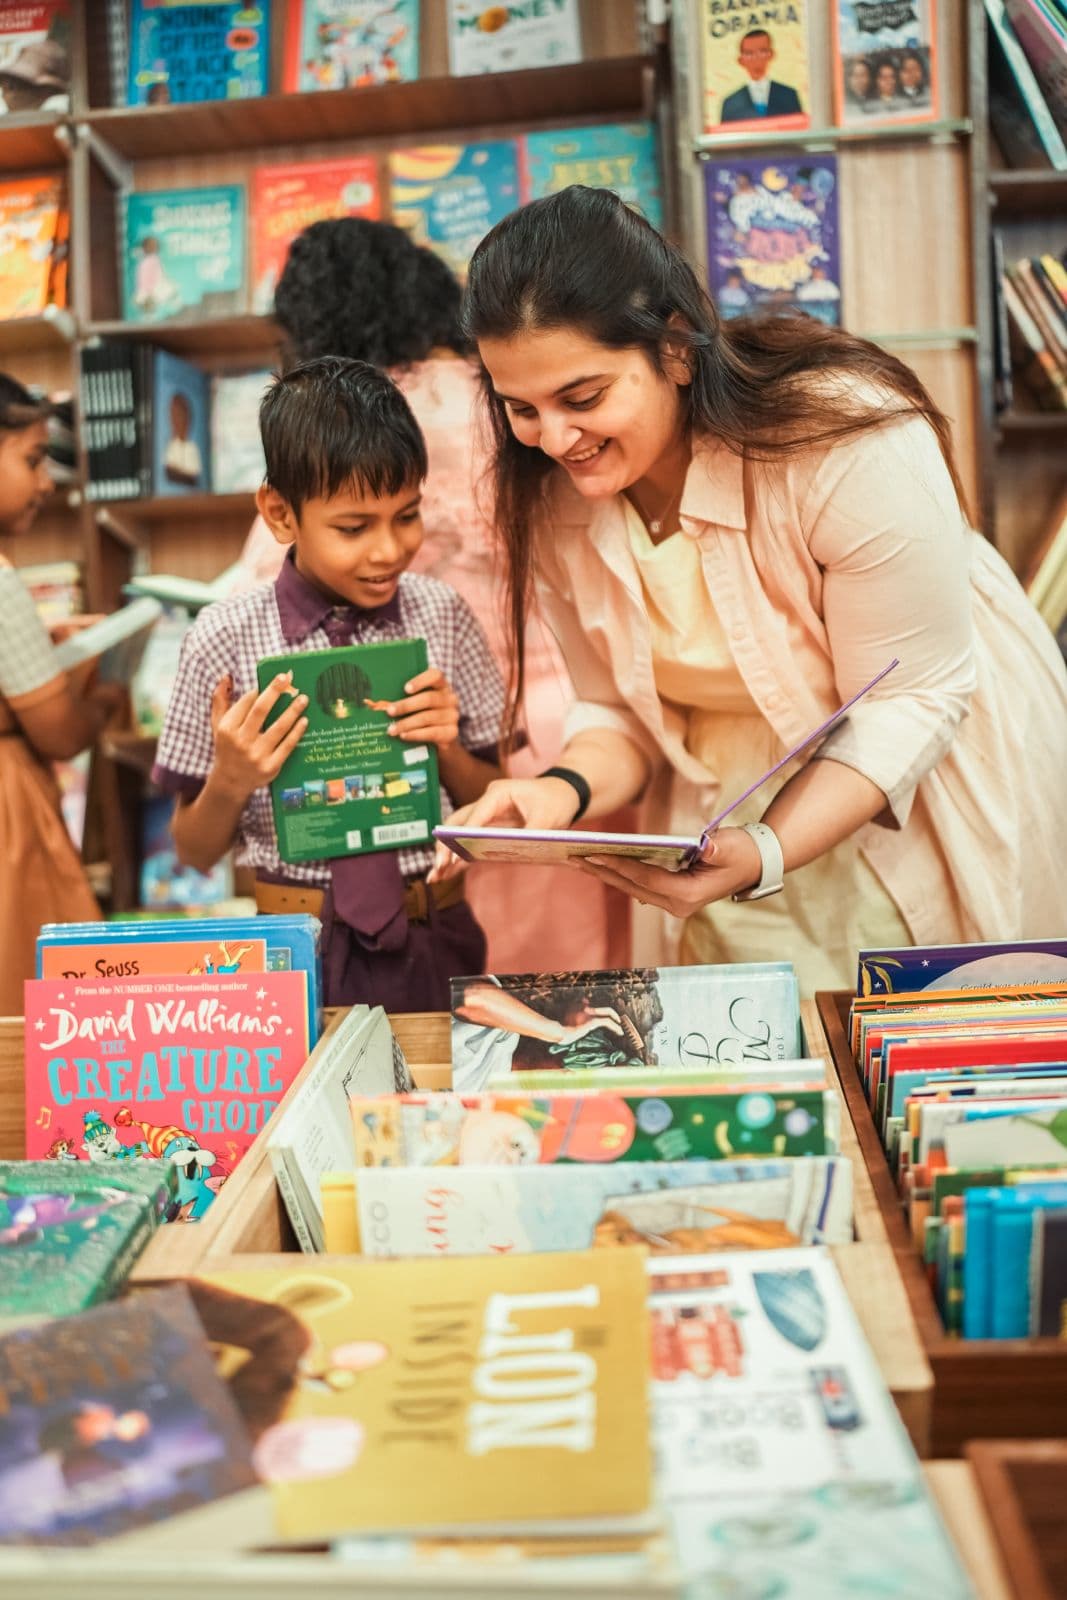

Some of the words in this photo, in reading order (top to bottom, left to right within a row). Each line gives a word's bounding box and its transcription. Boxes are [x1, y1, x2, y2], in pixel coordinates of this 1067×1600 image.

[710, 4, 799, 38] OBAMA
[94, 958, 140, 978] Seuss
[75, 985, 98, 996] From
[98, 985, 112, 995] the
[113, 984, 153, 995] NUMBER
[154, 983, 175, 993] ONE
[175, 982, 220, 993] bestselling
[220, 981, 249, 992] author
[40, 999, 137, 1051] David
[144, 998, 284, 1036] Walliams
[100, 1039, 127, 1055] THE
[47, 1045, 283, 1106] CREATURE
[465, 1283, 600, 1457] LION
